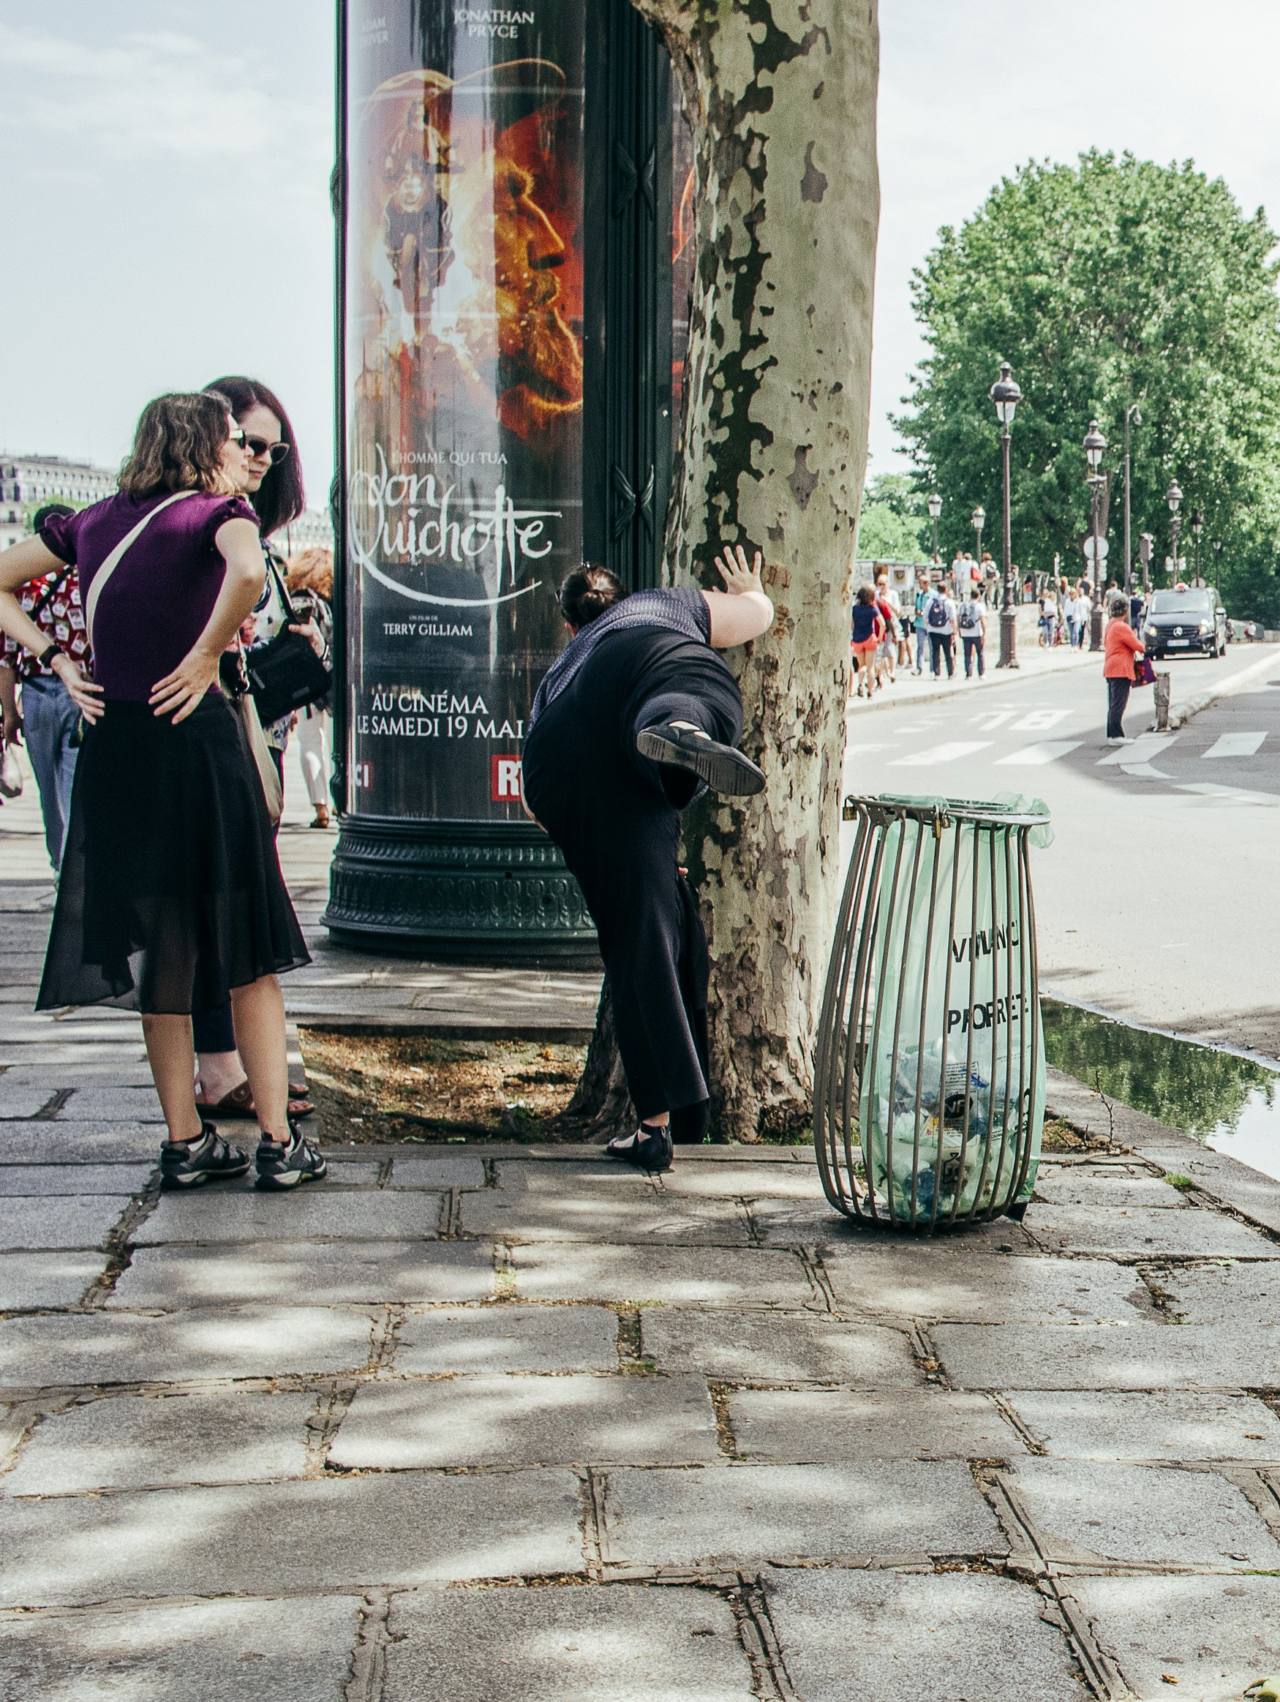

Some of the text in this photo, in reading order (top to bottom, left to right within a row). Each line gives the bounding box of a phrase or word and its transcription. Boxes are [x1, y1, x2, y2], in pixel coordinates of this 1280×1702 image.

[453, 9, 535, 25] JONATHAN
[468, 24, 519, 39] PRYCE
[449, 452, 475, 466] QUI
[479, 452, 508, 465] TUA
[383, 623, 473, 637] TERRY GILLIAM
[372, 690, 490, 715] AU CINÉMA
[371, 715, 439, 737] SAMEDI
[447, 715, 468, 738] 19
[475, 720, 524, 739] MAI
